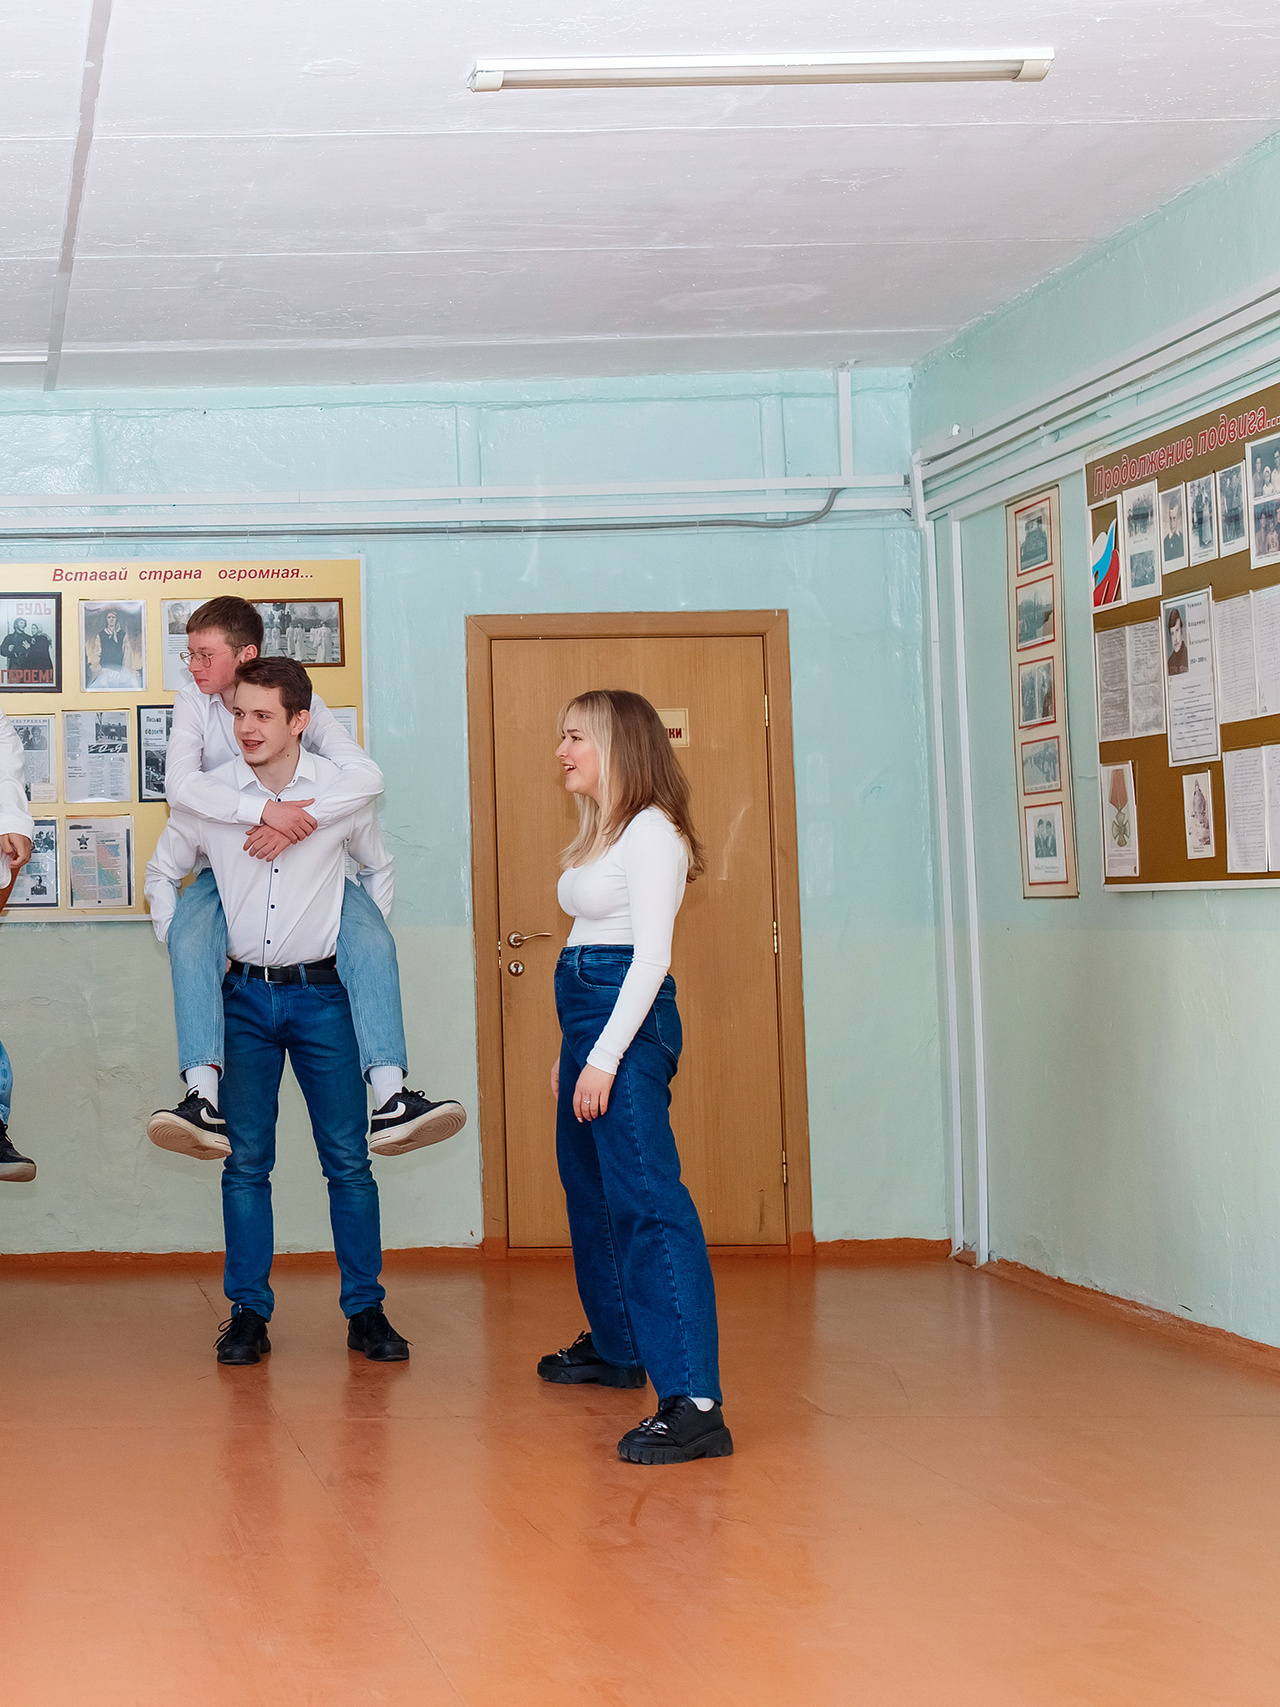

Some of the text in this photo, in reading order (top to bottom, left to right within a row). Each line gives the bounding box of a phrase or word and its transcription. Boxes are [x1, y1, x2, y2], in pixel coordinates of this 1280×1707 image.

[1093, 435, 1194, 498] Продолжение
[52, 567, 314, 583] Вставай страна огромная...
[16, 602, 52, 616] БУДЬ
[0, 668, 53, 684] ГЕРОЕМ!
